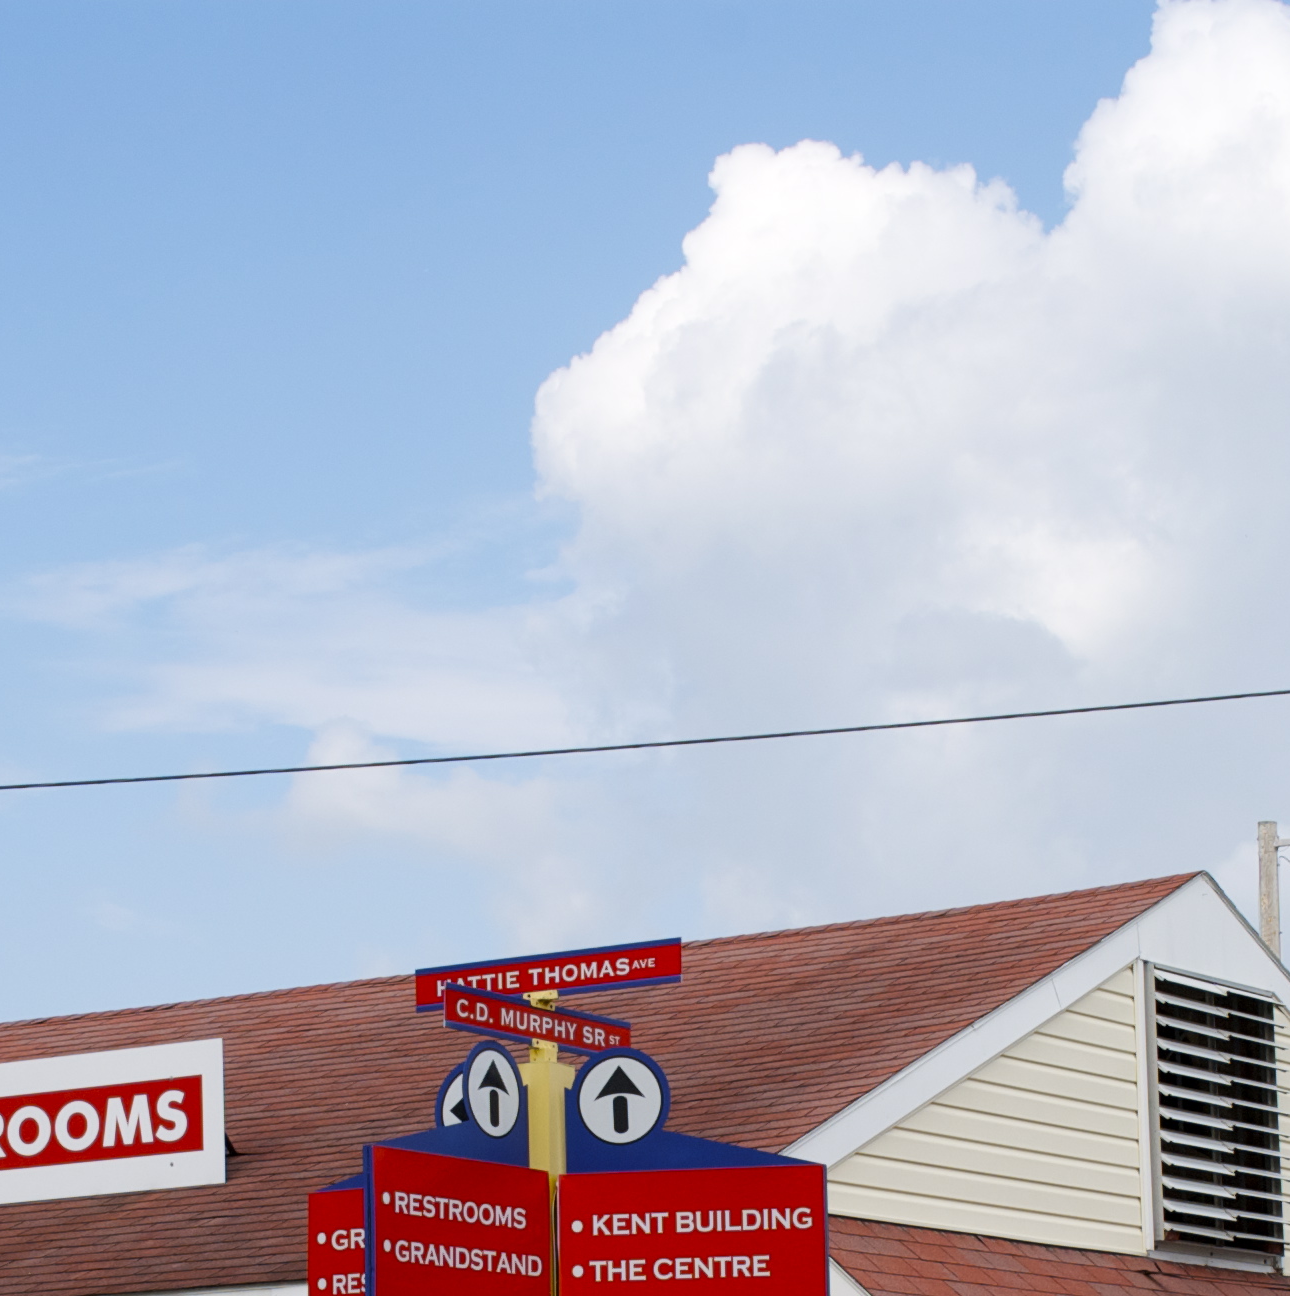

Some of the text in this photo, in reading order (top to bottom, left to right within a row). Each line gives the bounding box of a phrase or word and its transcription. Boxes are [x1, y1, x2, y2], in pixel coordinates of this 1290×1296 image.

[529, 958, 630, 986] THOMAS
[632, 957, 656, 970] AVE
[457, 999, 621, 1047] C.D. MURPHY SR ST
[394, 1191, 527, 1229] RESTROOMS
[592, 1207, 813, 1236] KENT BUILDING
[395, 1240, 543, 1277] GRANDSTAND
[590, 1255, 771, 1282] THE CENTRE
